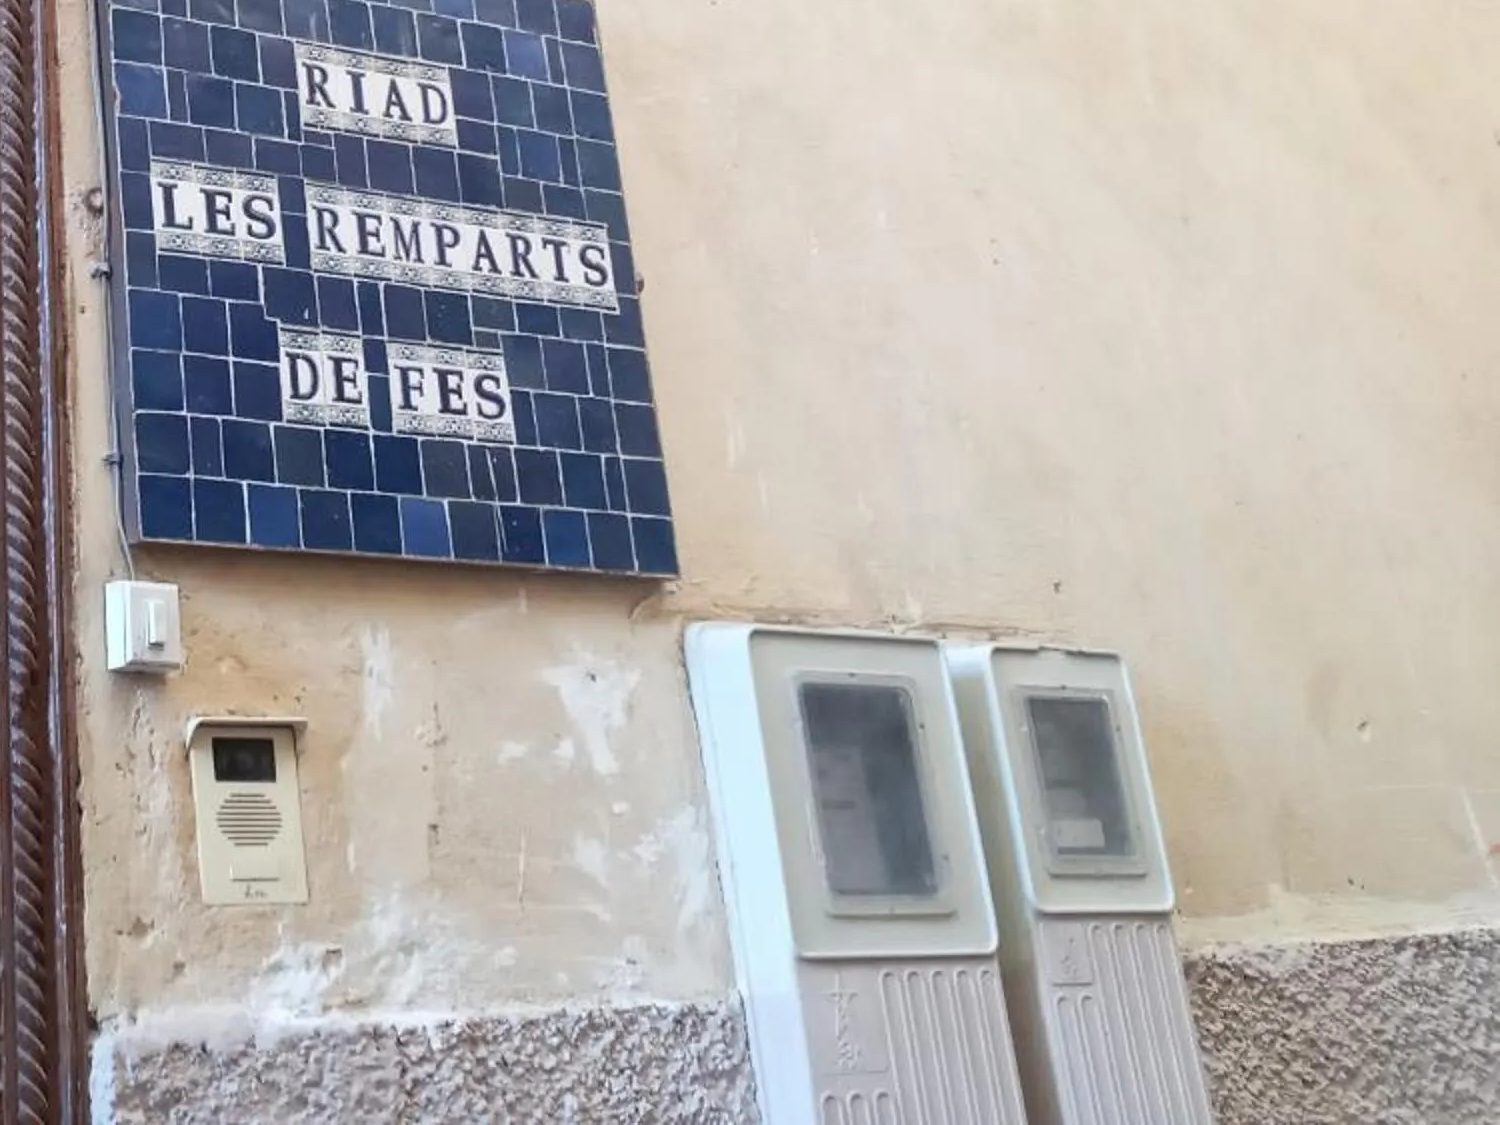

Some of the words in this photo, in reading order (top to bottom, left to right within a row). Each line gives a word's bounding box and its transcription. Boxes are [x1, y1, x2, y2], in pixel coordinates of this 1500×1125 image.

[302, 60, 450, 125] RIAD
[156, 182, 278, 240] LES
[311, 203, 610, 288] REMPARTS
[287, 350, 364, 408] DE
[394, 365, 507, 419] FES
